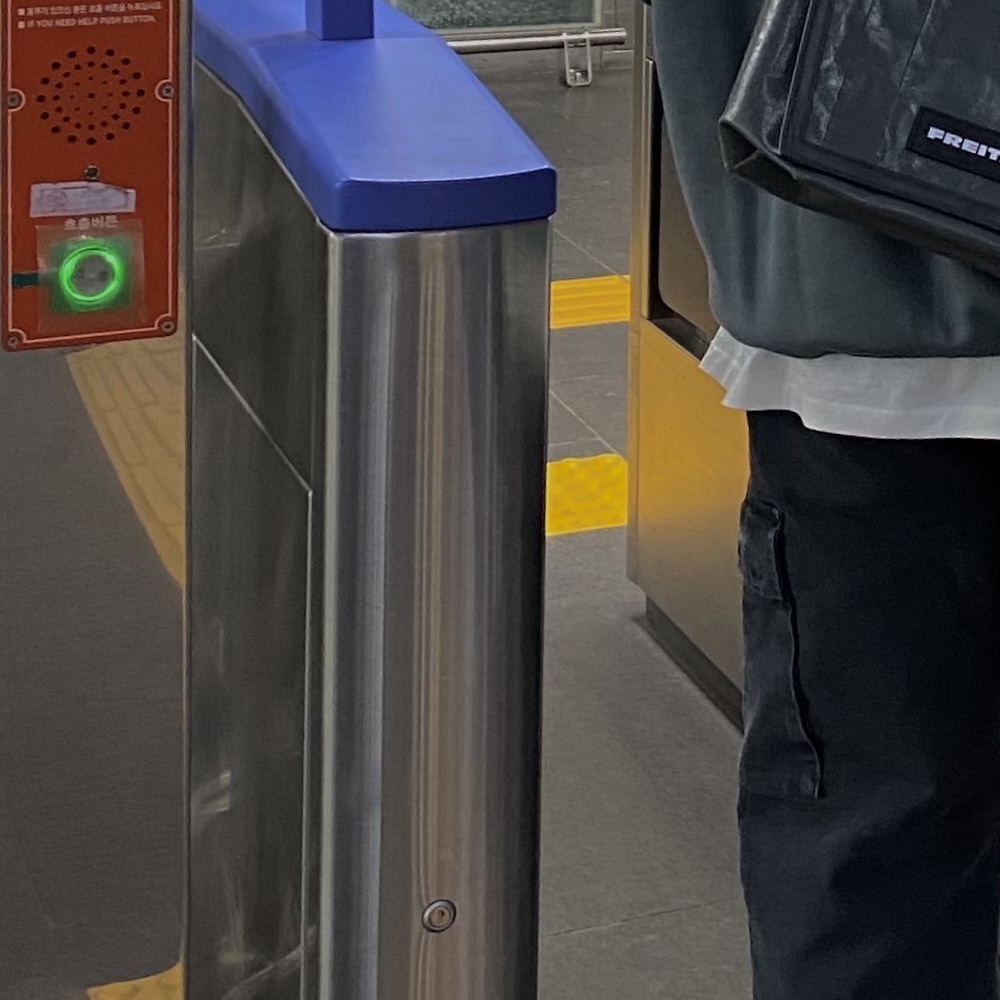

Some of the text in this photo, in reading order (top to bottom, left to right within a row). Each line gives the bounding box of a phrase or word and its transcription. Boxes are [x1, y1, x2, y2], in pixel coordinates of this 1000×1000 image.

[36, 19, 53, 28] YOU
[55, 18, 77, 27] NEED
[78, 17, 98, 26] HELP
[100, 16, 122, 25] PUSH
